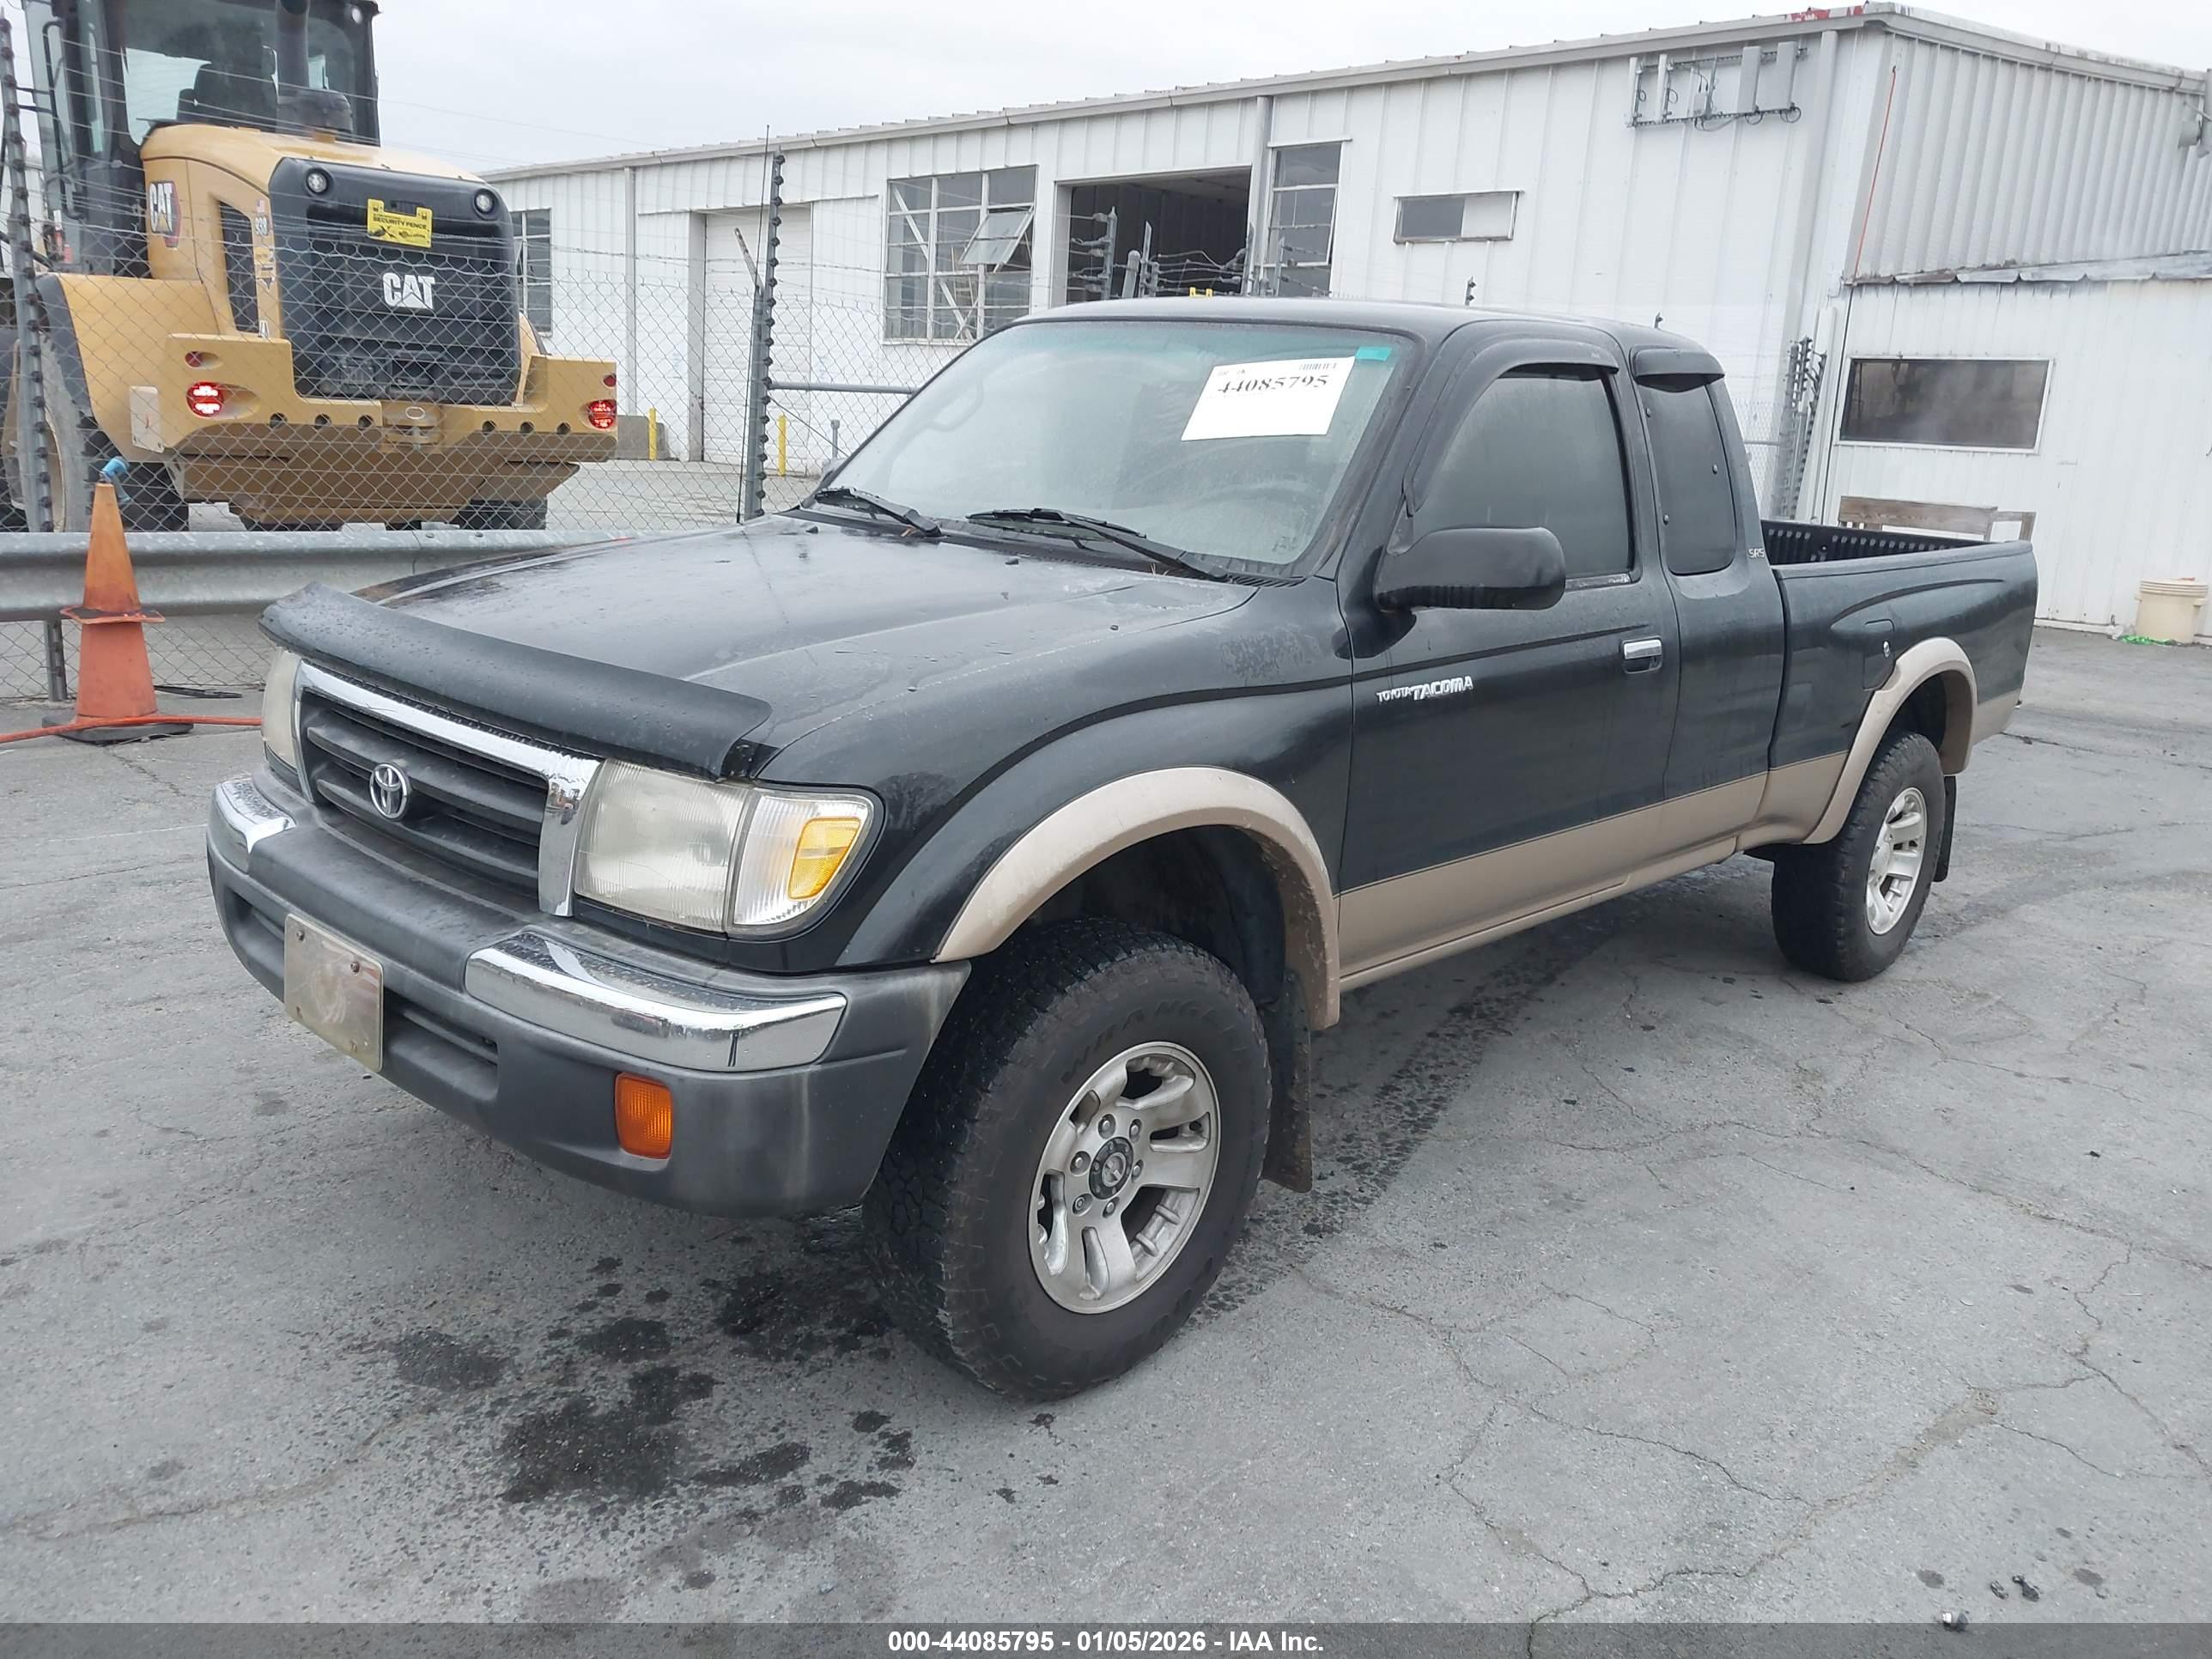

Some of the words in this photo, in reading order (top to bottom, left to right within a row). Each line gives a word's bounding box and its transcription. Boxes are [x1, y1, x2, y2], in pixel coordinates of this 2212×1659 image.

[149, 182, 173, 233] CAT
[373, 216, 405, 226] SECURITY
[383, 272, 435, 310] CAT
[1218, 374, 1329, 393] 44085795
[1376, 687, 1412, 702] TOYOTA
[1412, 676, 1474, 701] TACOMA
